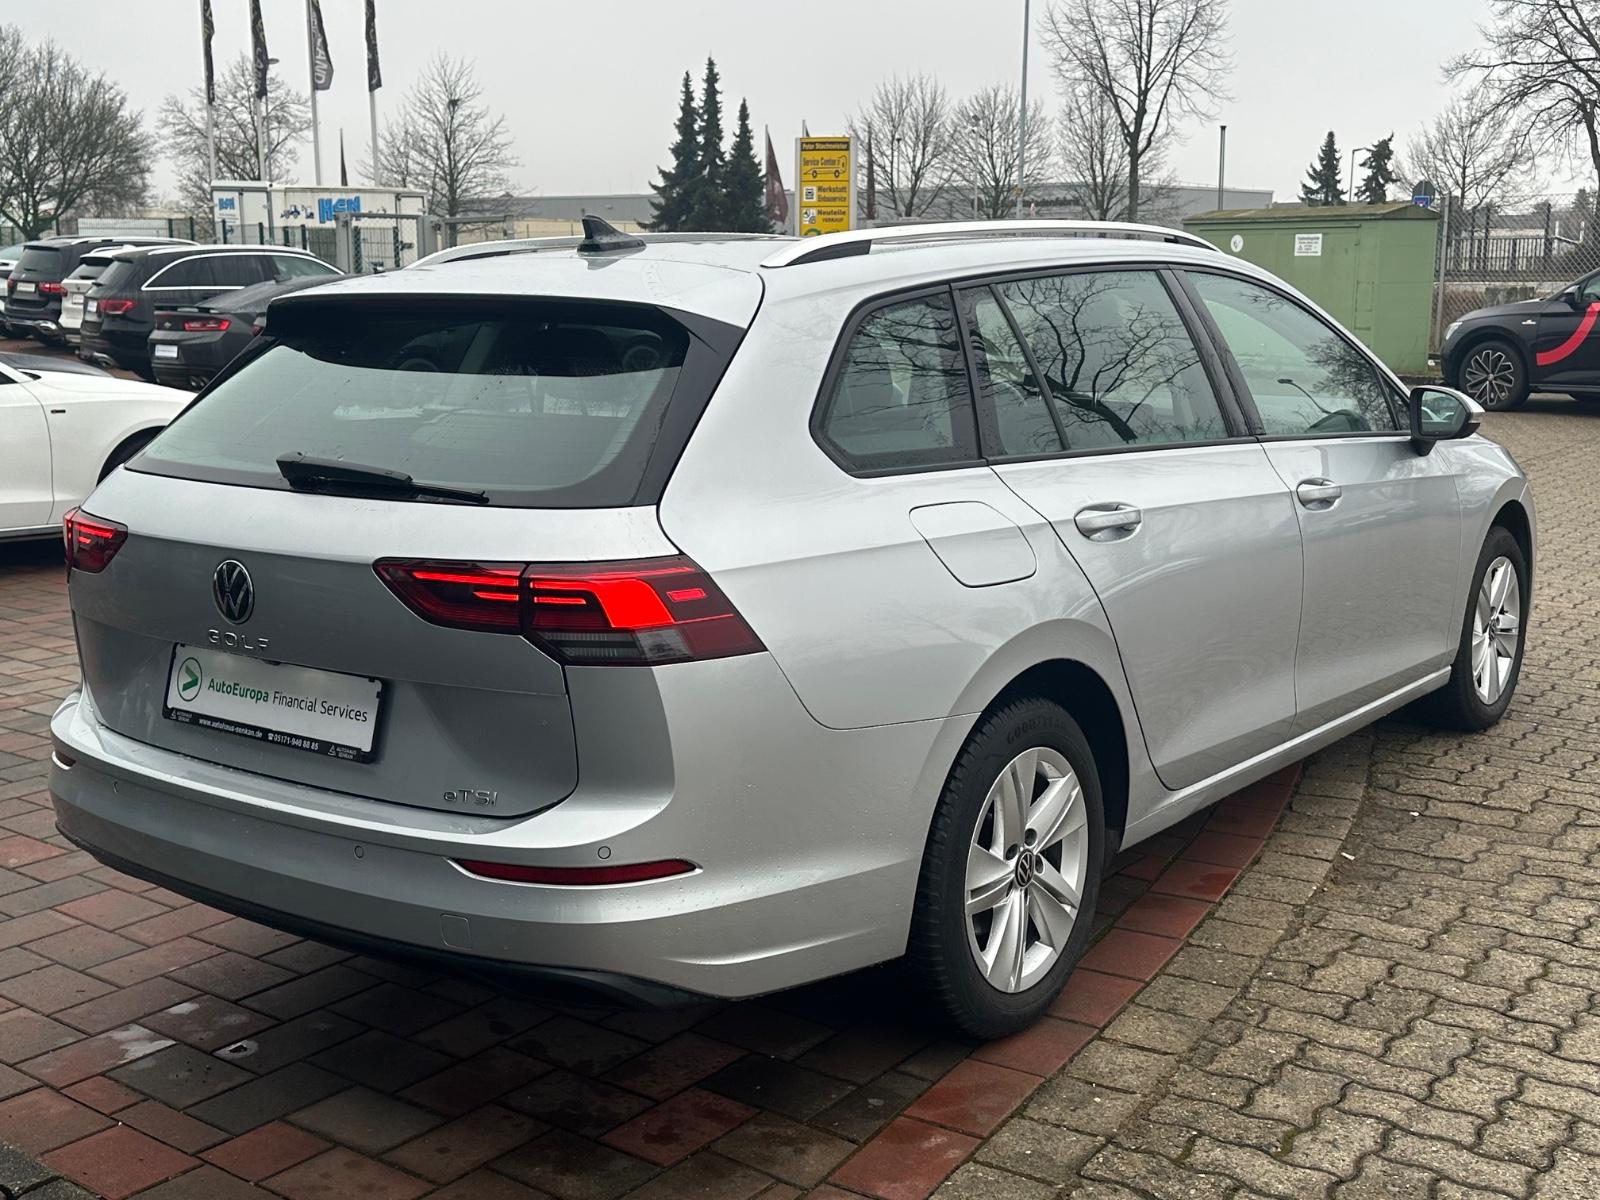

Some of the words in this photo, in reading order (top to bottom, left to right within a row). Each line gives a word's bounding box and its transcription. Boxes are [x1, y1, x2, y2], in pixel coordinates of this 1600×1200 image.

[803, 157, 820, 166] Service
[208, 628, 270, 652] GOLF
[207, 677, 269, 704] AutoEuropa
[272, 690, 318, 713] Financial
[320, 700, 368, 723] Services
